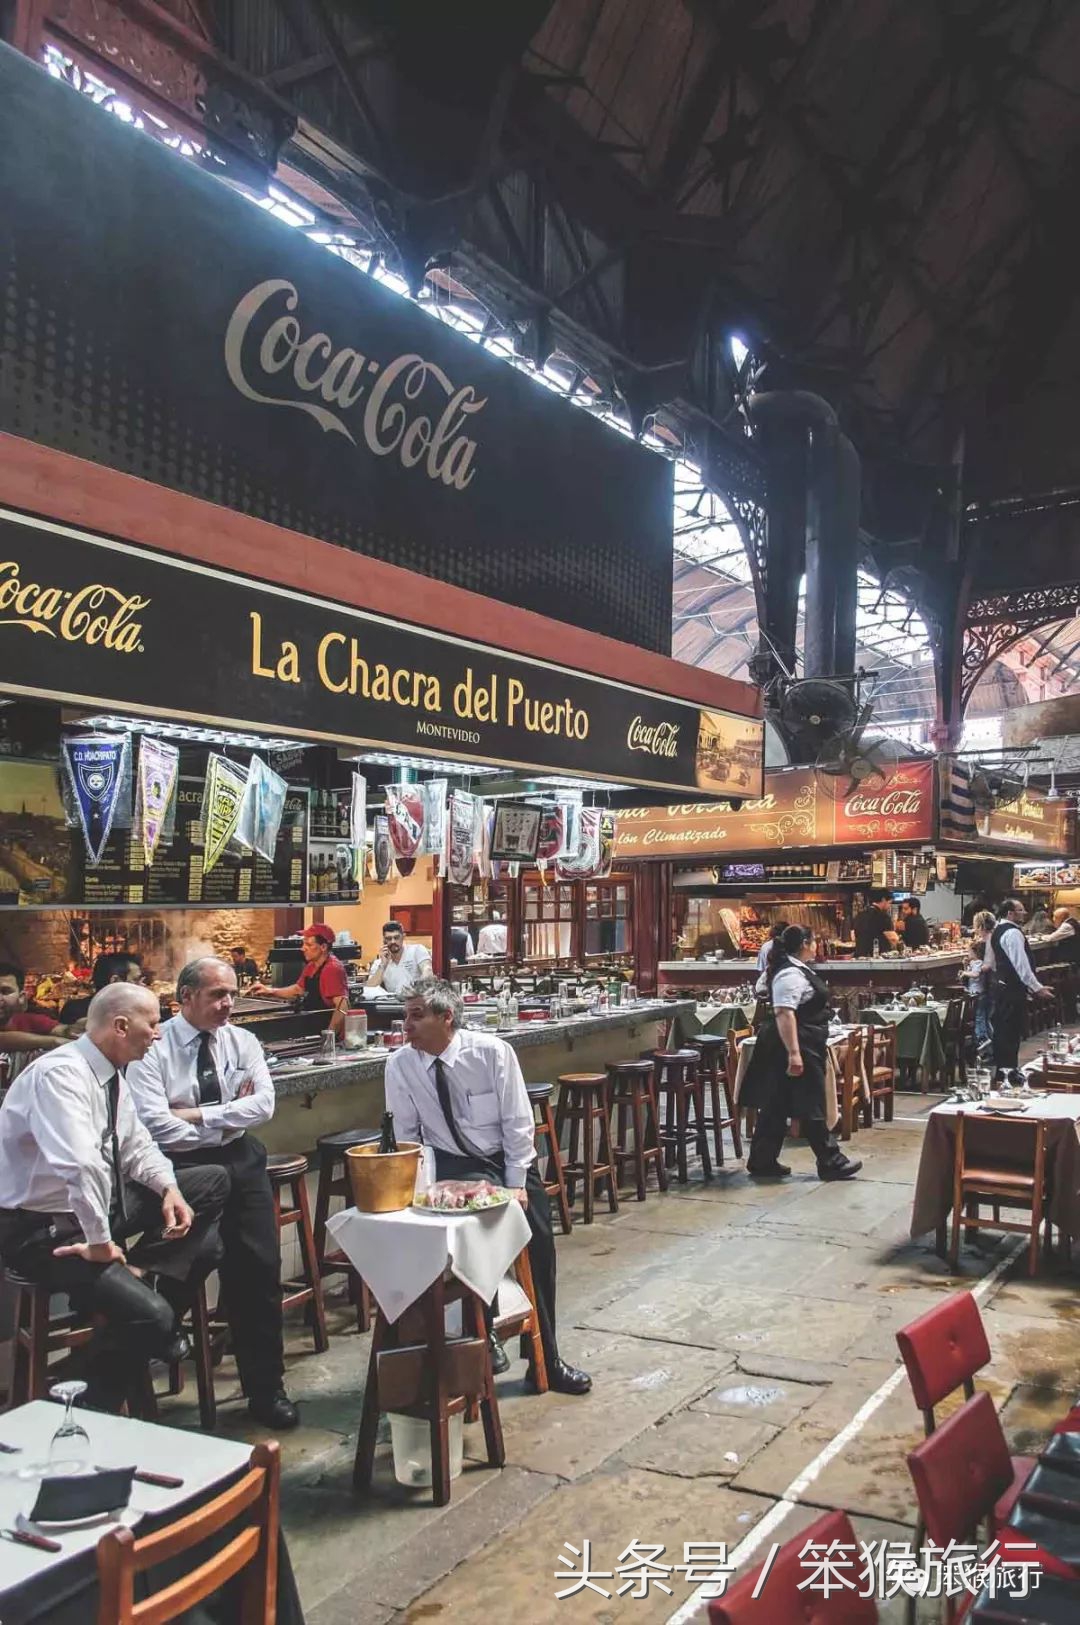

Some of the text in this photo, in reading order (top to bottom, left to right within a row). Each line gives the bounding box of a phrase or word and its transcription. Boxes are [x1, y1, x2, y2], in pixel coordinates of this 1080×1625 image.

[224, 279, 488, 490] Coca-Cola
[250, 612, 589, 740] La Chacra del Puerto
[416, 721, 481, 744] MONTEVIDEO
[627, 715, 680, 757] Coca-Cola
[178, 791, 202, 803] acra
[844, 789, 922, 817] Coca-Cola
[617, 825, 728, 845] lón Climatizado
